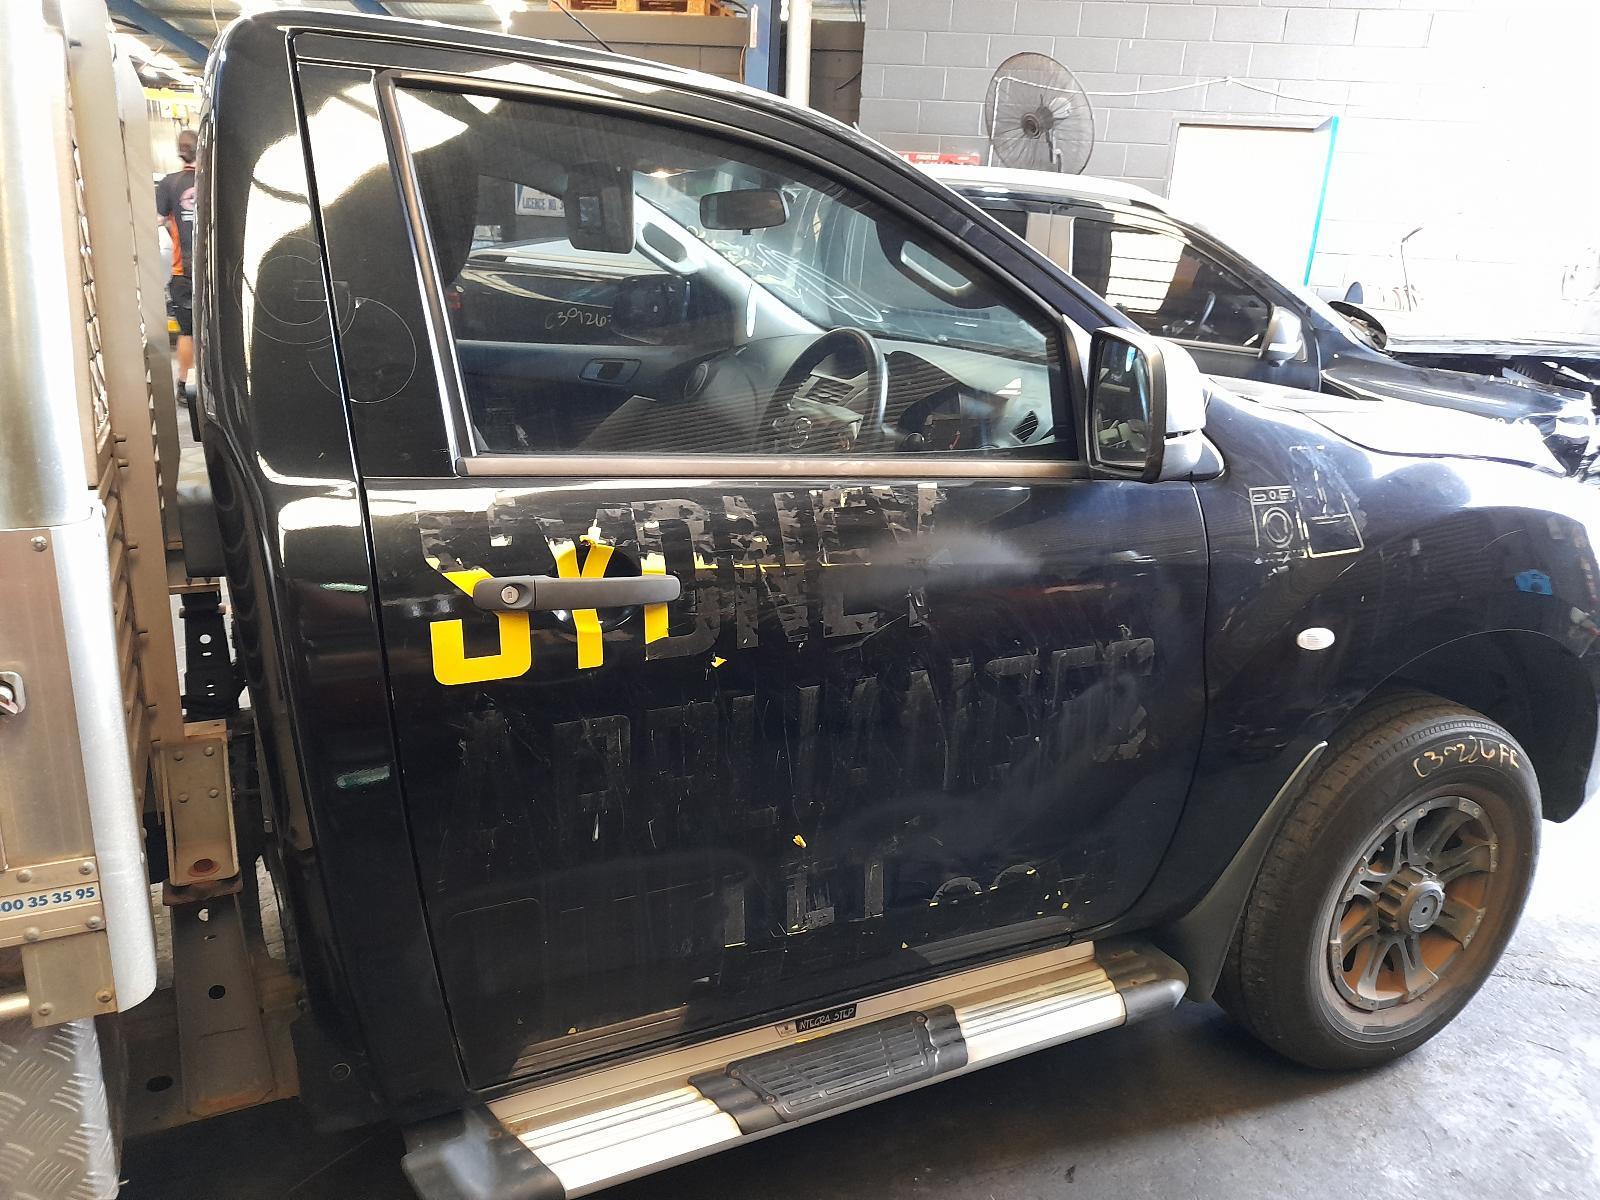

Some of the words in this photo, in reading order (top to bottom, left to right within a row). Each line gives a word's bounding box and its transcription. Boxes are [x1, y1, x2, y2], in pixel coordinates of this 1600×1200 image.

[0, 899, 24, 912] 00
[28, 895, 48, 908] 35
[52, 890, 72, 903] 35
[75, 886, 95, 900] 95
